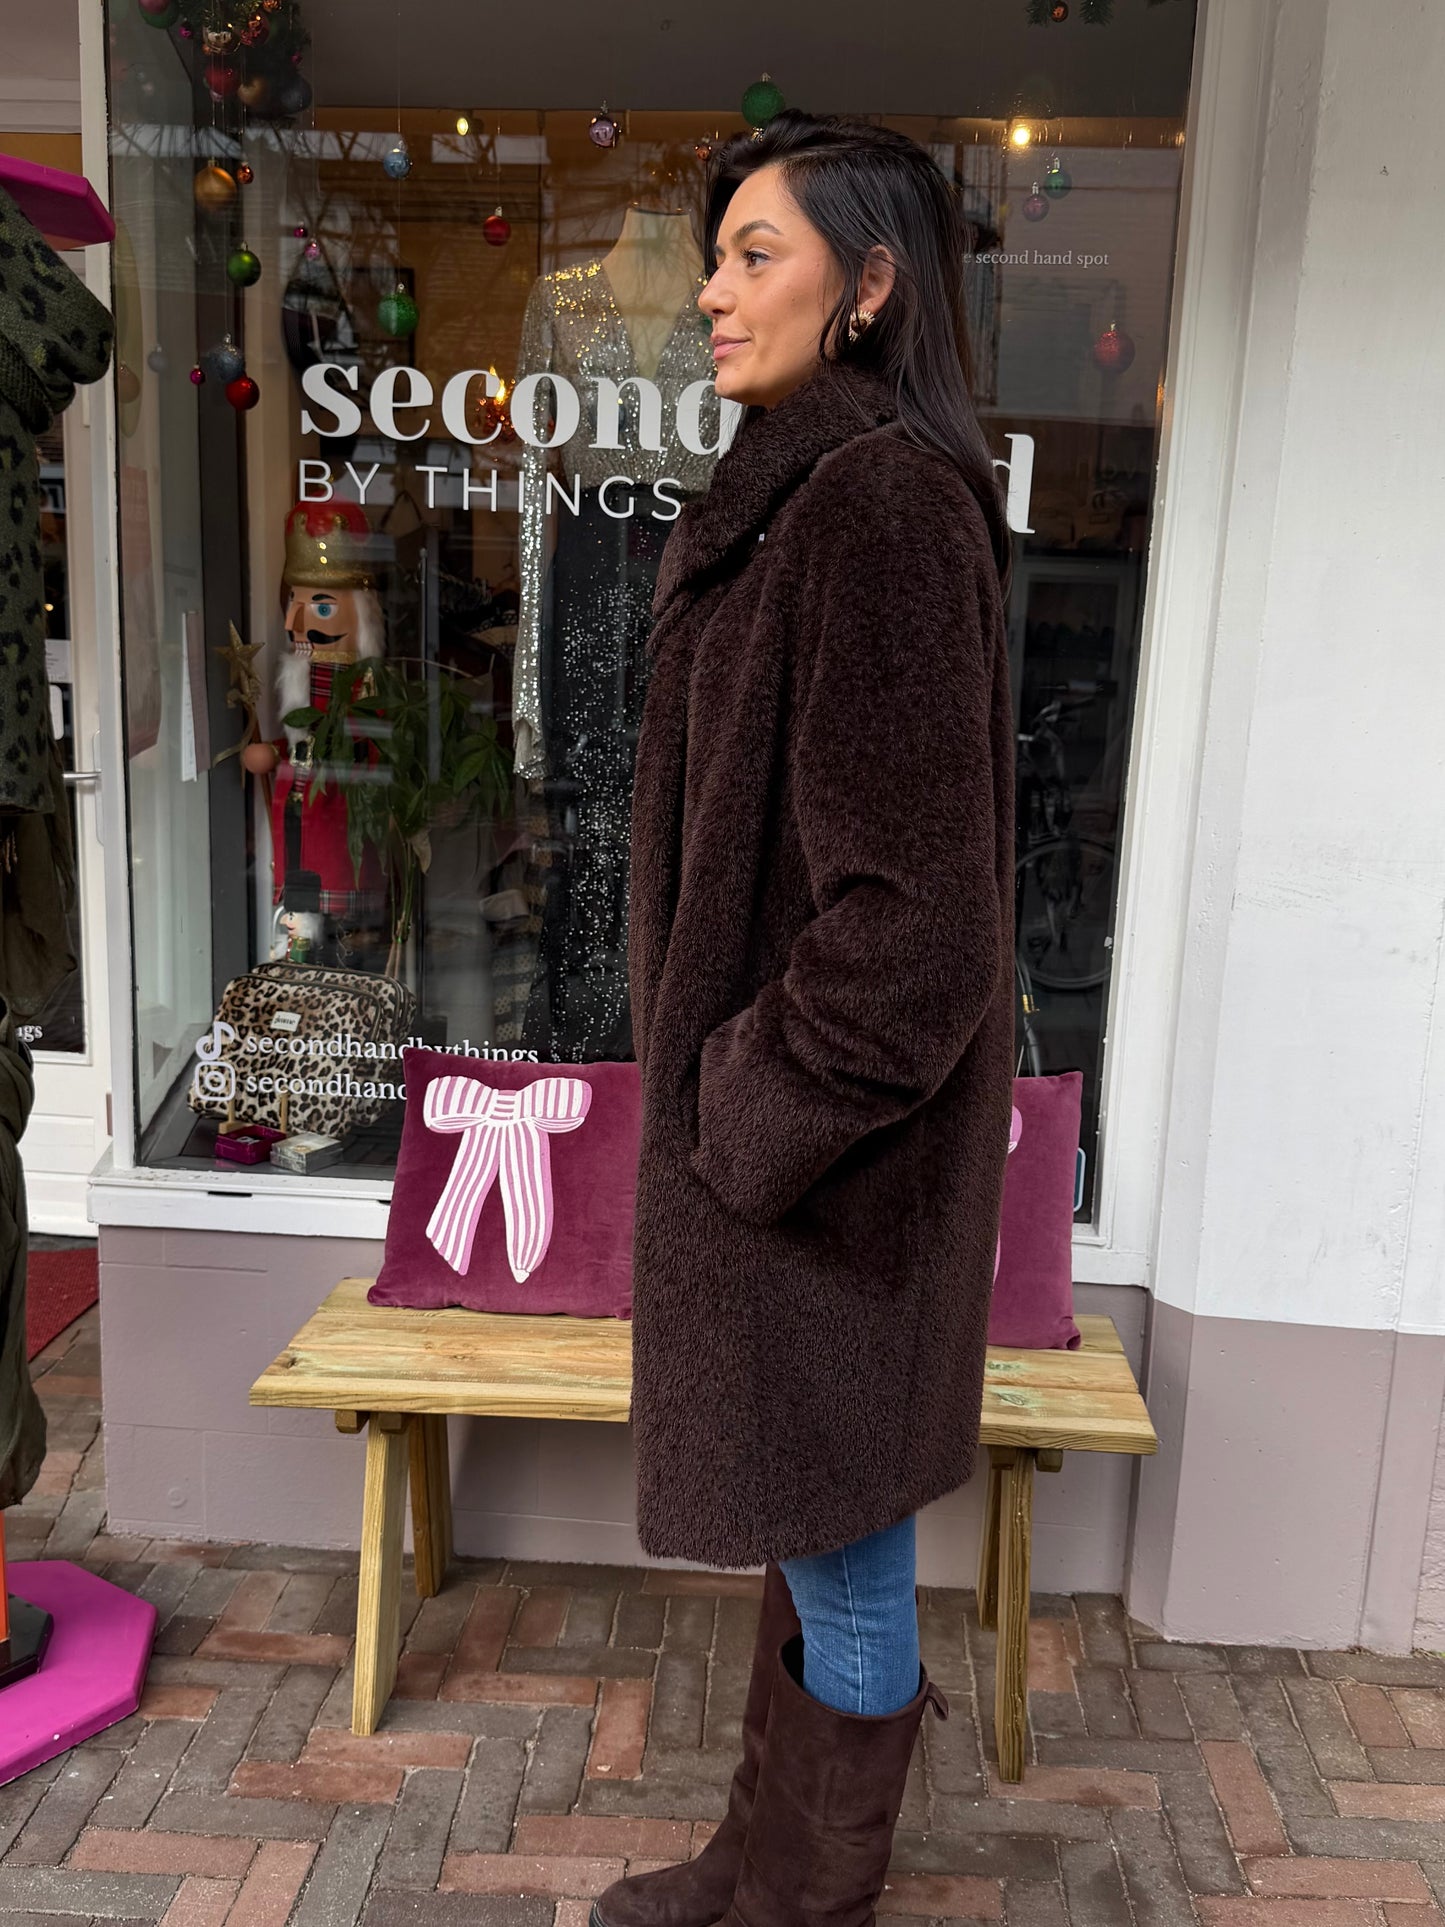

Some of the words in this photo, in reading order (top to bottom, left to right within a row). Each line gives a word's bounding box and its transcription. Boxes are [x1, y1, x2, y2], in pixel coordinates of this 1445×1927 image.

[975, 250, 1029, 265] second
[1034, 250, 1073, 265] hand
[1076, 253, 1109, 268] spot
[299, 459, 381, 505] BY
[415, 465, 683, 521] THINGS
